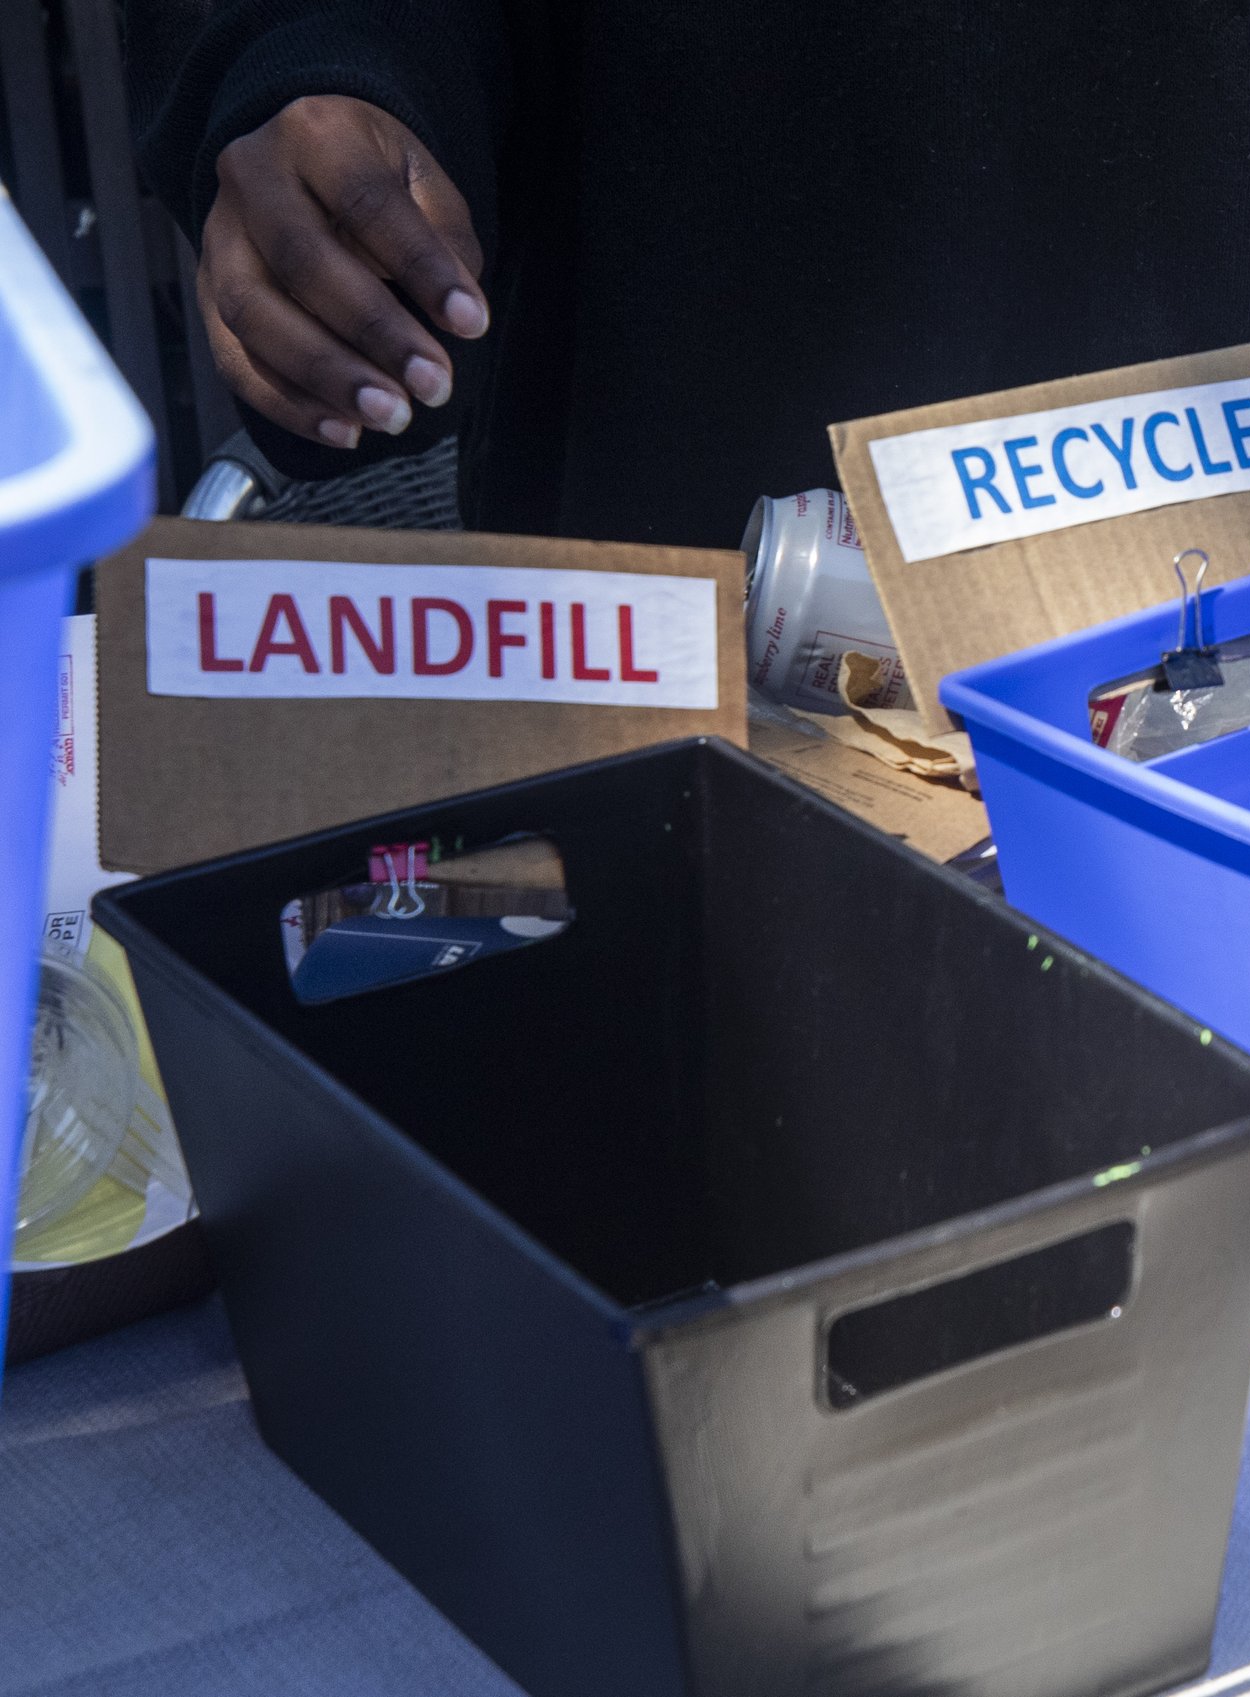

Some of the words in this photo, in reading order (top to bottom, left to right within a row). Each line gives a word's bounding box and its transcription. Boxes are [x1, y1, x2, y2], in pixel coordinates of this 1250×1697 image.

[198, 592, 658, 682] LANDFILL
[766, 607, 787, 640] lime
[812, 653, 836, 689] REAL
